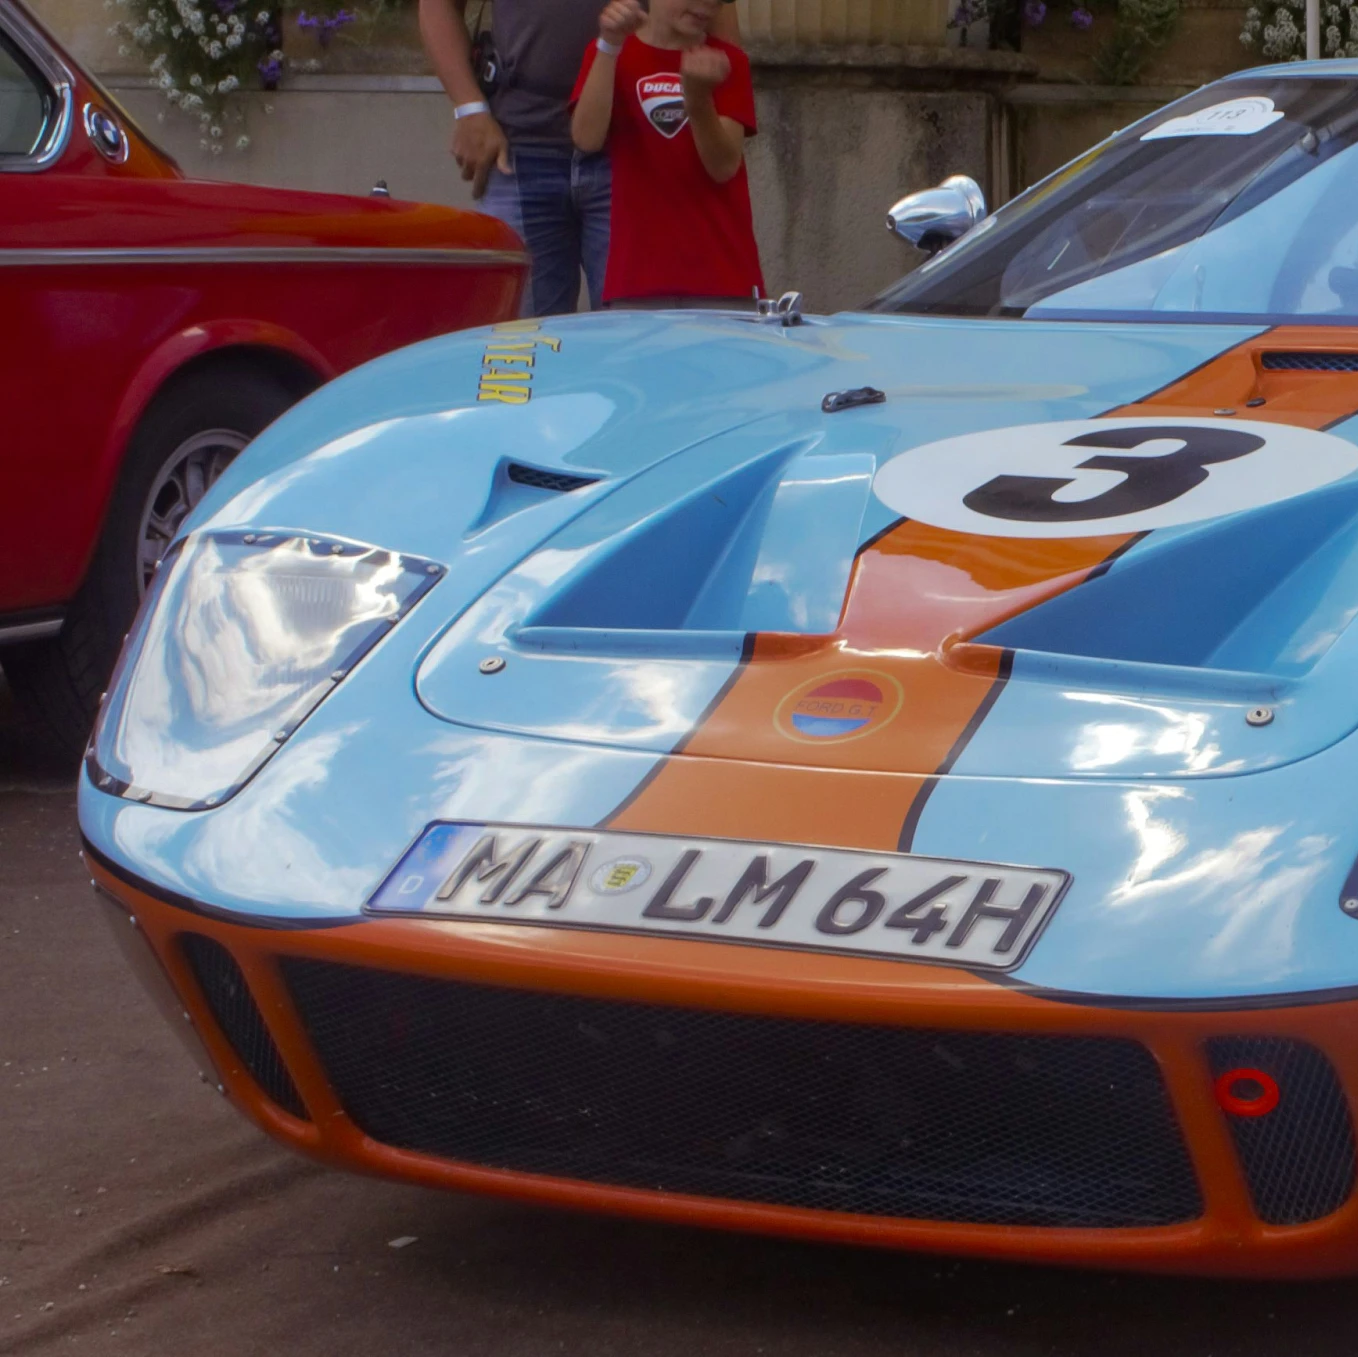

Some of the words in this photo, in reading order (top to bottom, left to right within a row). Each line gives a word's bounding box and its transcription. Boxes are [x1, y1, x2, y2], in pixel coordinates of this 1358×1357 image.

[643, 82, 683, 93] DUCA
[962, 426, 1267, 522] 3
[795, 700, 844, 714] FORD
[435, 835, 592, 910] MA
[640, 849, 816, 930] LM
[815, 866, 1047, 954] 64H
